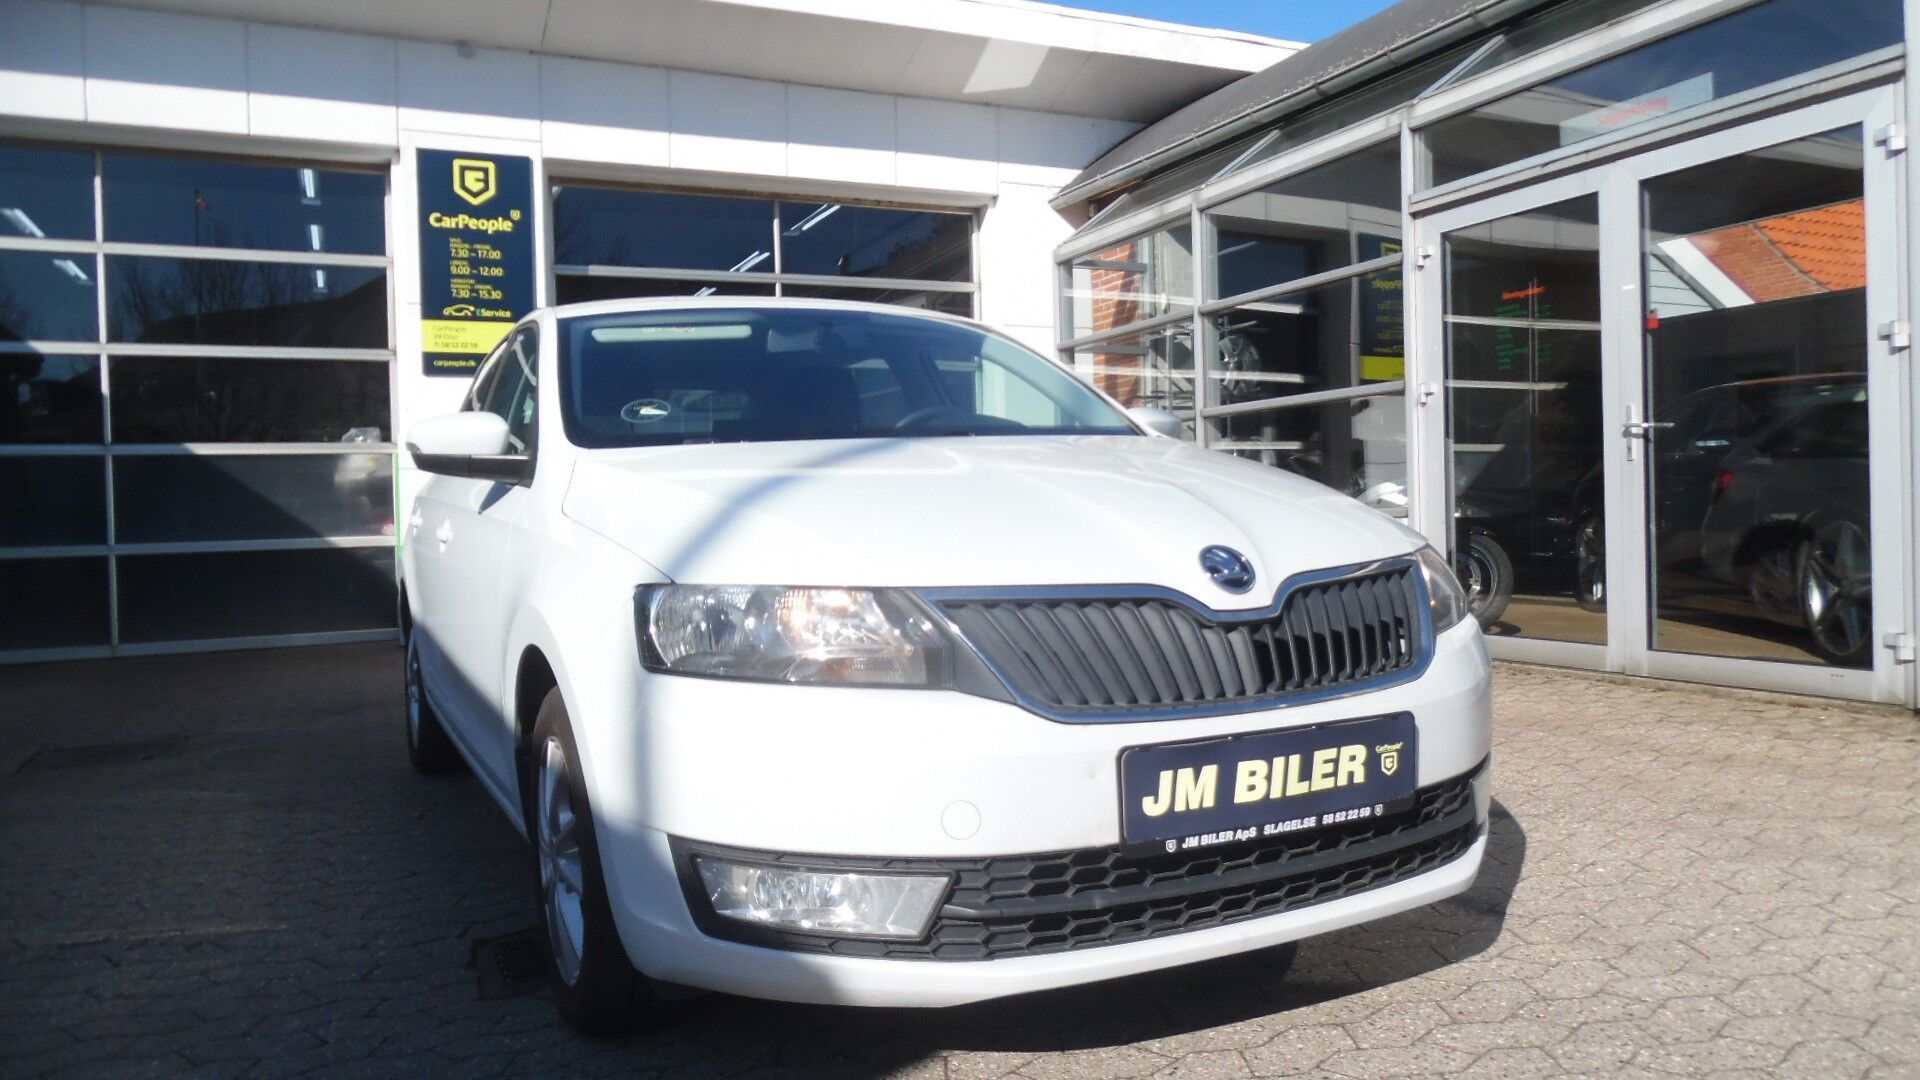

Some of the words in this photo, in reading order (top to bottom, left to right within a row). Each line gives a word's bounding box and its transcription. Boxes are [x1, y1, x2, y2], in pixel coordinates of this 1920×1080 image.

[429, 212, 514, 234] CarPeople
[450, 249, 469, 258] 7.30
[478, 250, 502, 260] 17.00
[479, 266, 503, 277] 12.00
[479, 290, 502, 300] 15.30
[1142, 764, 1219, 817] JM
[1234, 744, 1367, 804] BILER
[1182, 836, 1199, 849] JM
[1200, 829, 1235, 846] BILER
[1234, 826, 1257, 842] ApS
[1263, 816, 1317, 836] SLAGELSE
